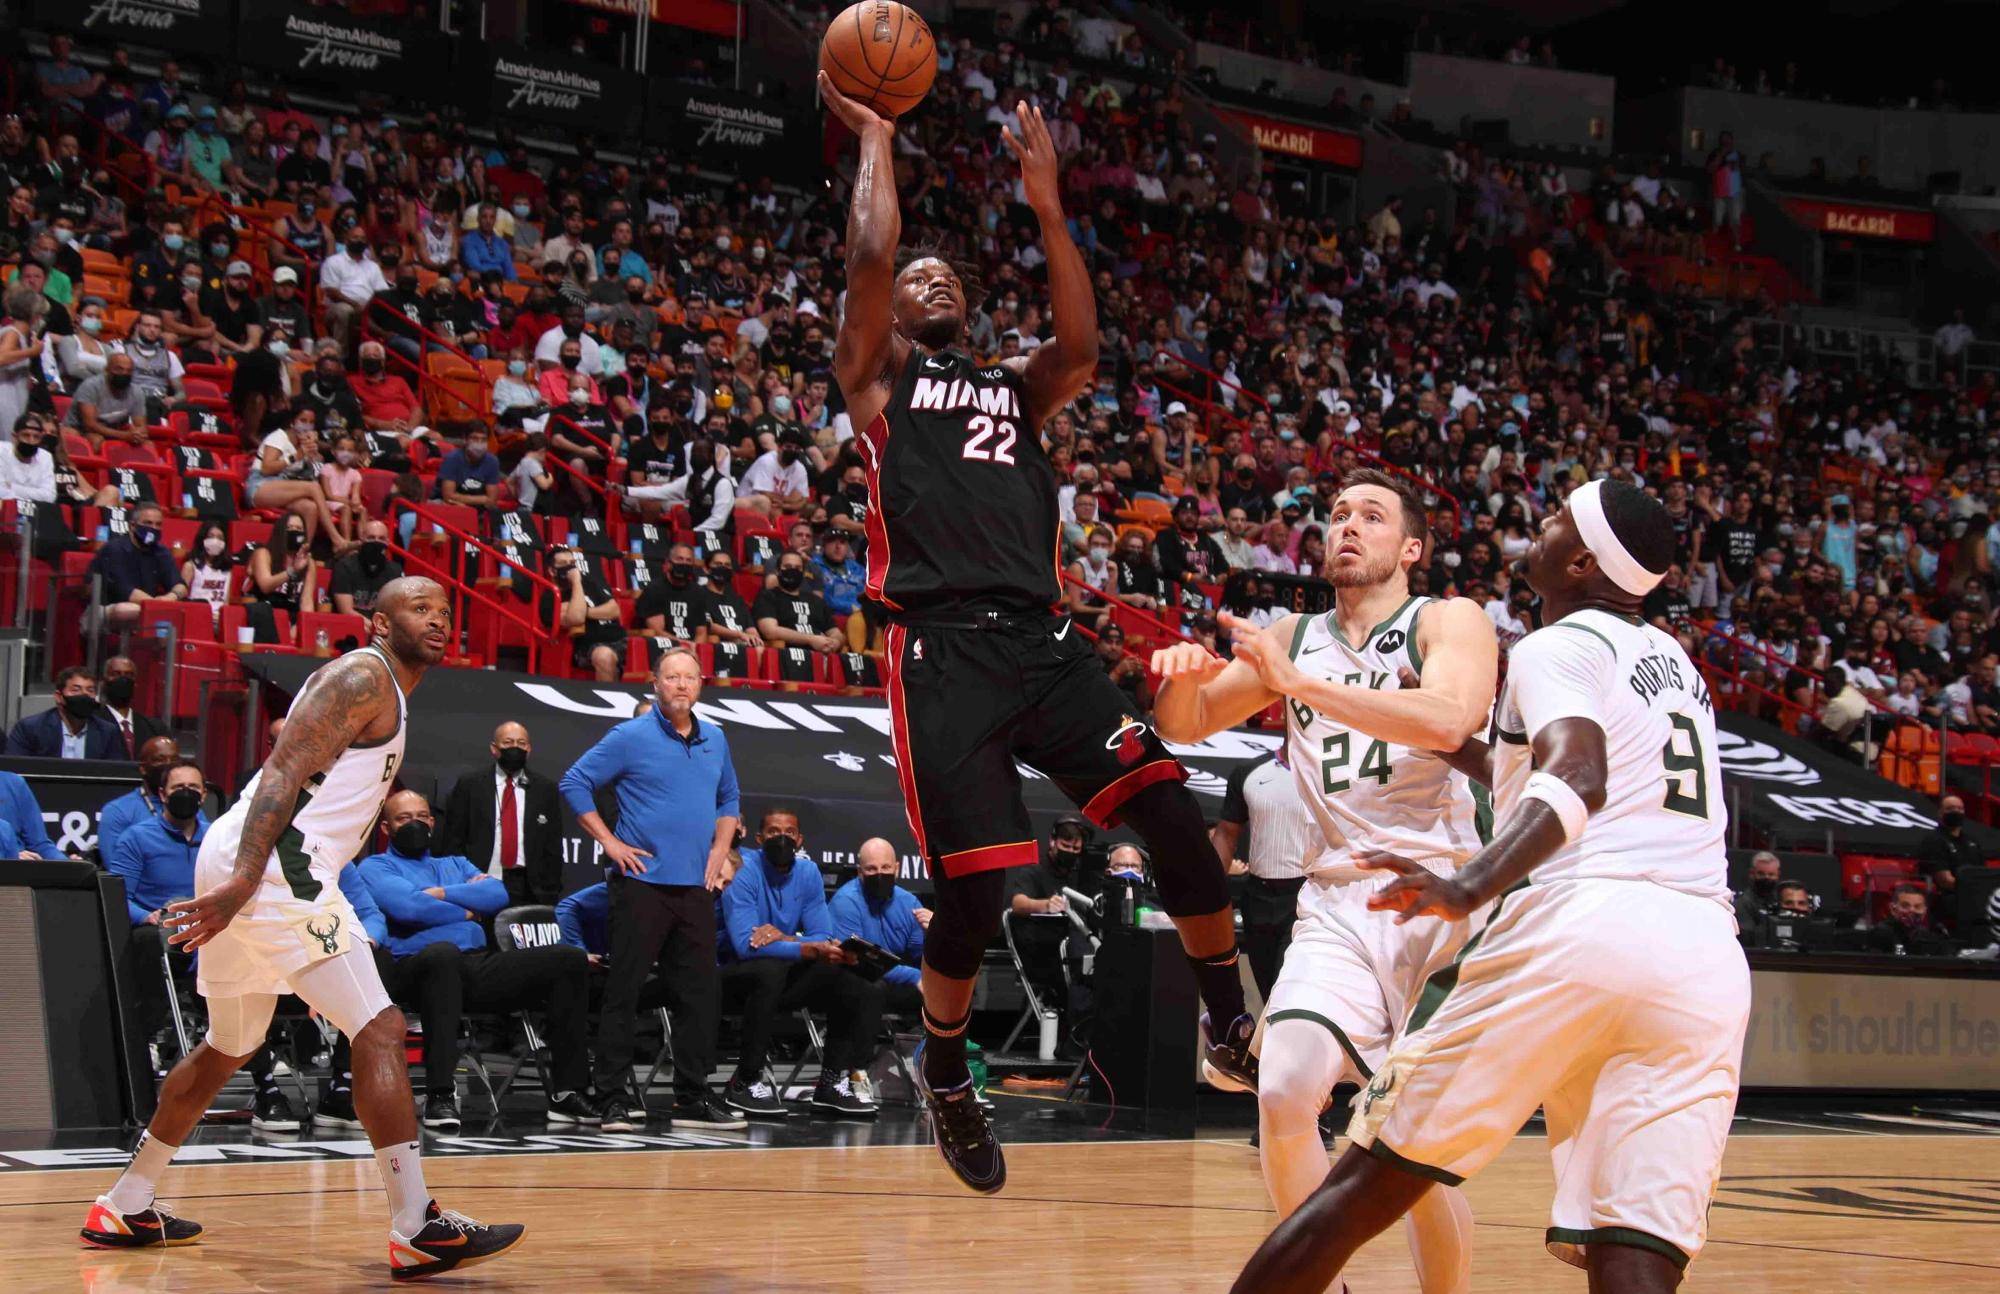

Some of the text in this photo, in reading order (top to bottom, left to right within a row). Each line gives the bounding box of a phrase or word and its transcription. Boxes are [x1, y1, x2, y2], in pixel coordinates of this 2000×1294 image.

[286, 14, 401, 51] AmericanAirlines
[299, 37, 380, 70] Arena
[495, 57, 600, 92] AmericanAirlines
[507, 80, 580, 110] Arena
[686, 97, 783, 130] AmericanAirlines
[697, 119, 764, 146] Arena
[980, 368, 1003, 380] KG
[910, 377, 1021, 419] MIAMI
[962, 415, 1017, 466] 22
[56, 473, 77, 484] EAT
[1629, 654, 1684, 708] PORTIS
[1321, 731, 1394, 795] 24
[1662, 711, 1710, 820] 9
[1767, 793, 1940, 830] AT&T
[1771, 996, 1799, 1053] it
[1807, 998, 1941, 1055] should
[1951, 1001, 2000, 1058] be
